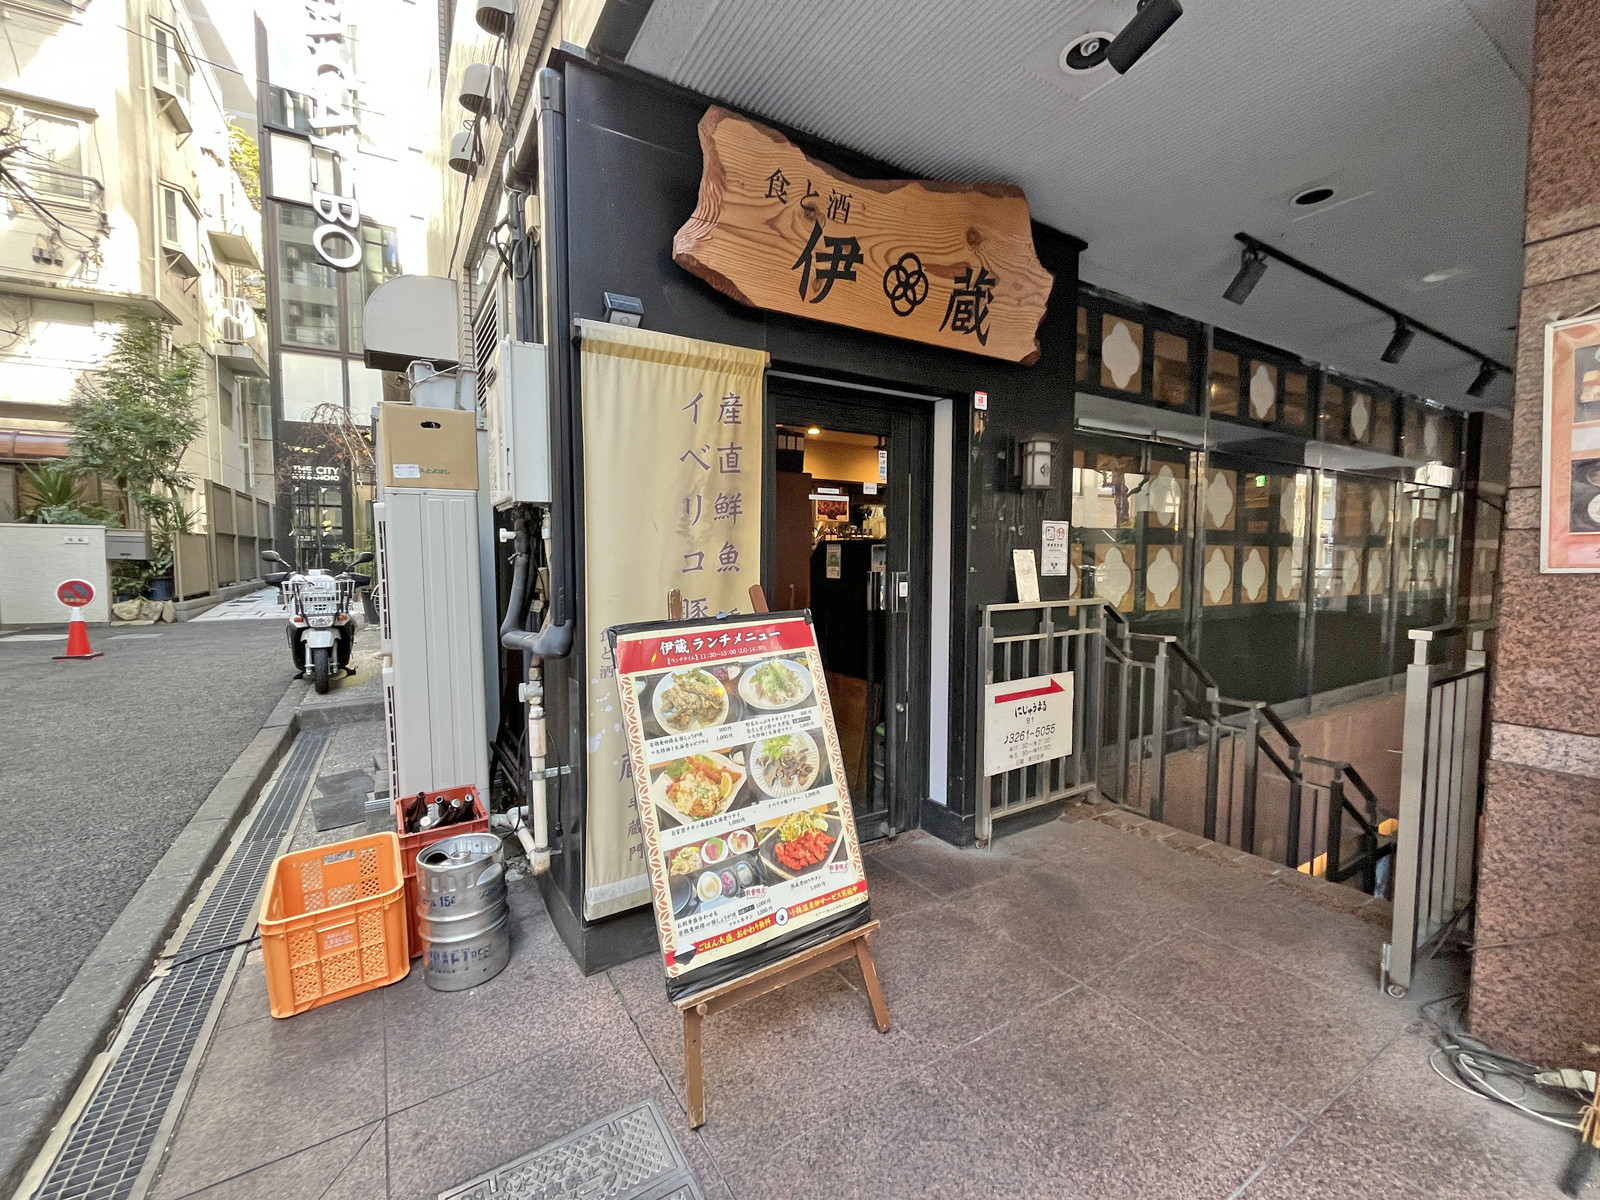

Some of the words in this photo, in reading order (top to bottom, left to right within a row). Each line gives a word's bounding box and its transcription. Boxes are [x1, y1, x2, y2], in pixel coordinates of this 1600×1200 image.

[764, 168, 853, 224] 食と酒
[316, 466, 339, 475] CITY
[679, 391, 711, 619] イベリコ豚
[713, 391, 743, 614] 産直鮮魚
[660, 637, 690, 656] 伊蔵
[692, 630, 781, 651] ランチメニュー
